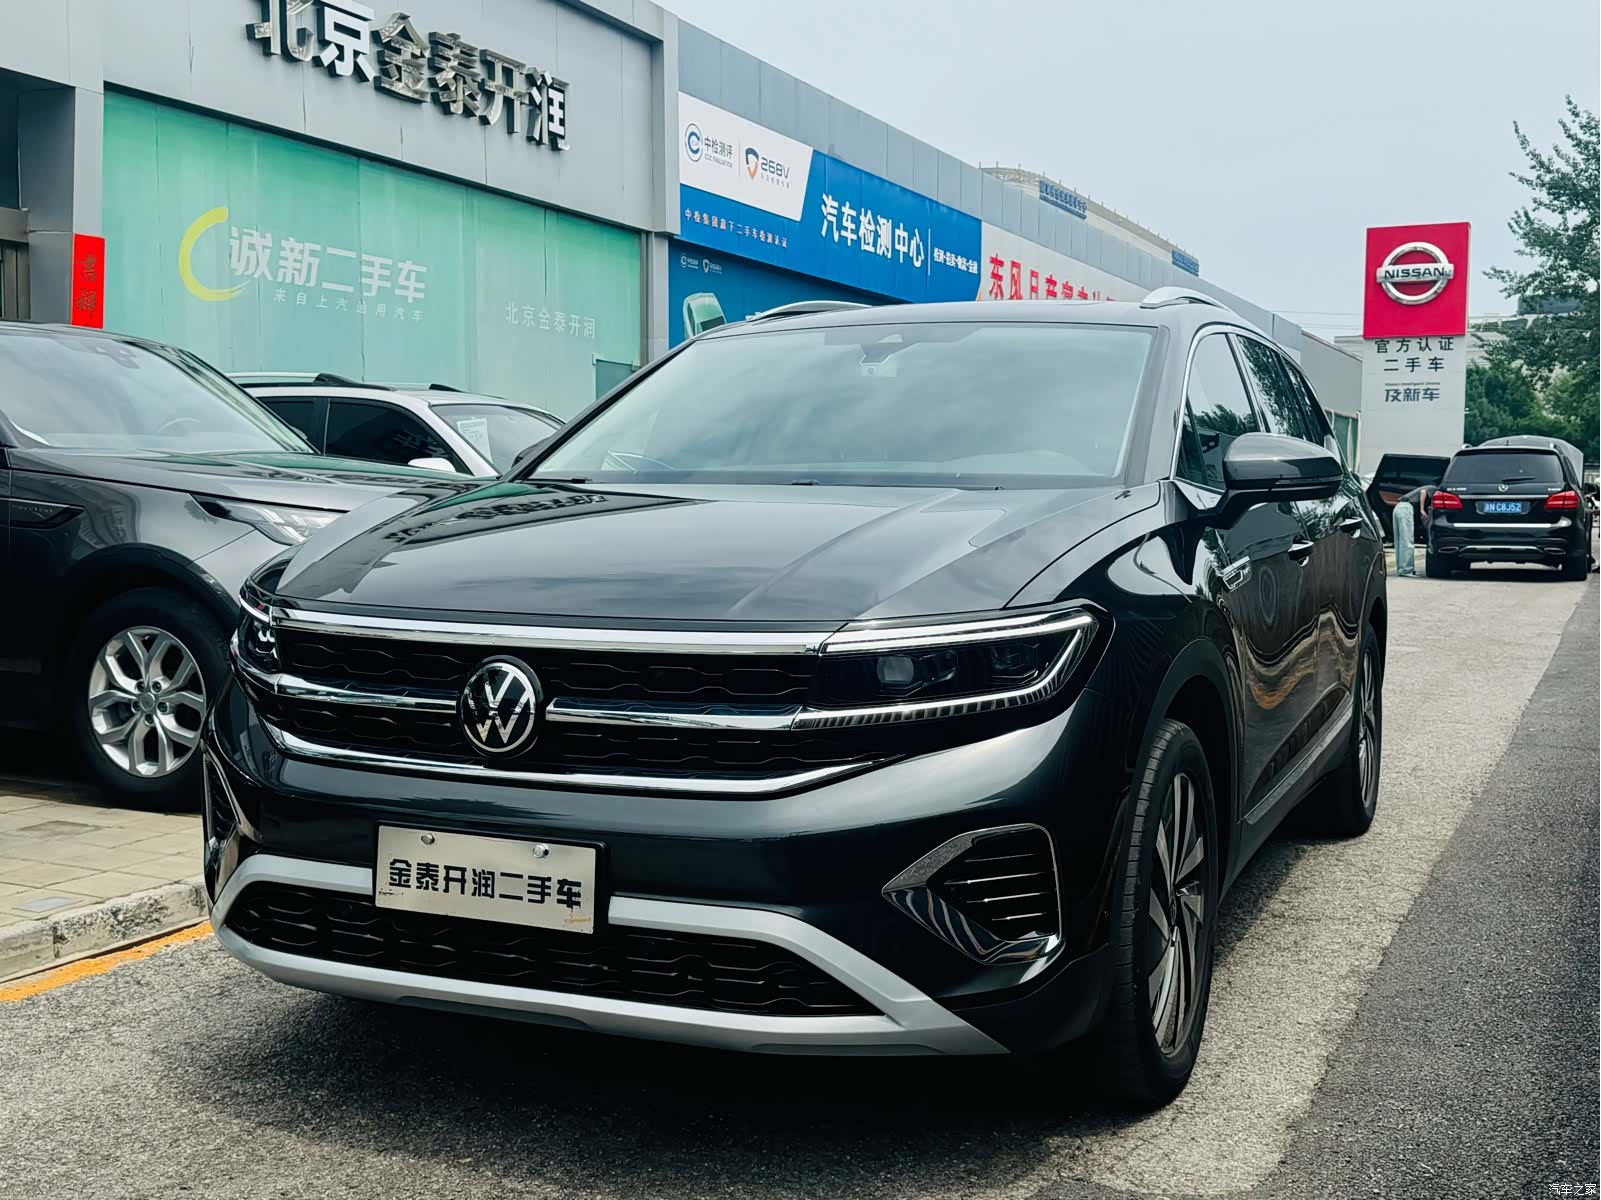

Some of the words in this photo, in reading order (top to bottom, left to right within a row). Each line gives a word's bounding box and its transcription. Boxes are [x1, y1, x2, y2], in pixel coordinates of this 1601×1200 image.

[246, 0, 570, 151] 北京金泰开润
[760, 156, 790, 179] 268V
[821, 193, 924, 268] 汽车检测中心
[230, 226, 428, 303] 诚新二手车
[1384, 267, 1445, 279] NISSAN
[505, 301, 596, 340] 北京金泰开润
[1374, 336, 1455, 354] 官方认证
[1383, 356, 1445, 373] 二手车
[1384, 388, 1441, 402] 及新车
[388, 858, 582, 910] 金泰开润二手车
